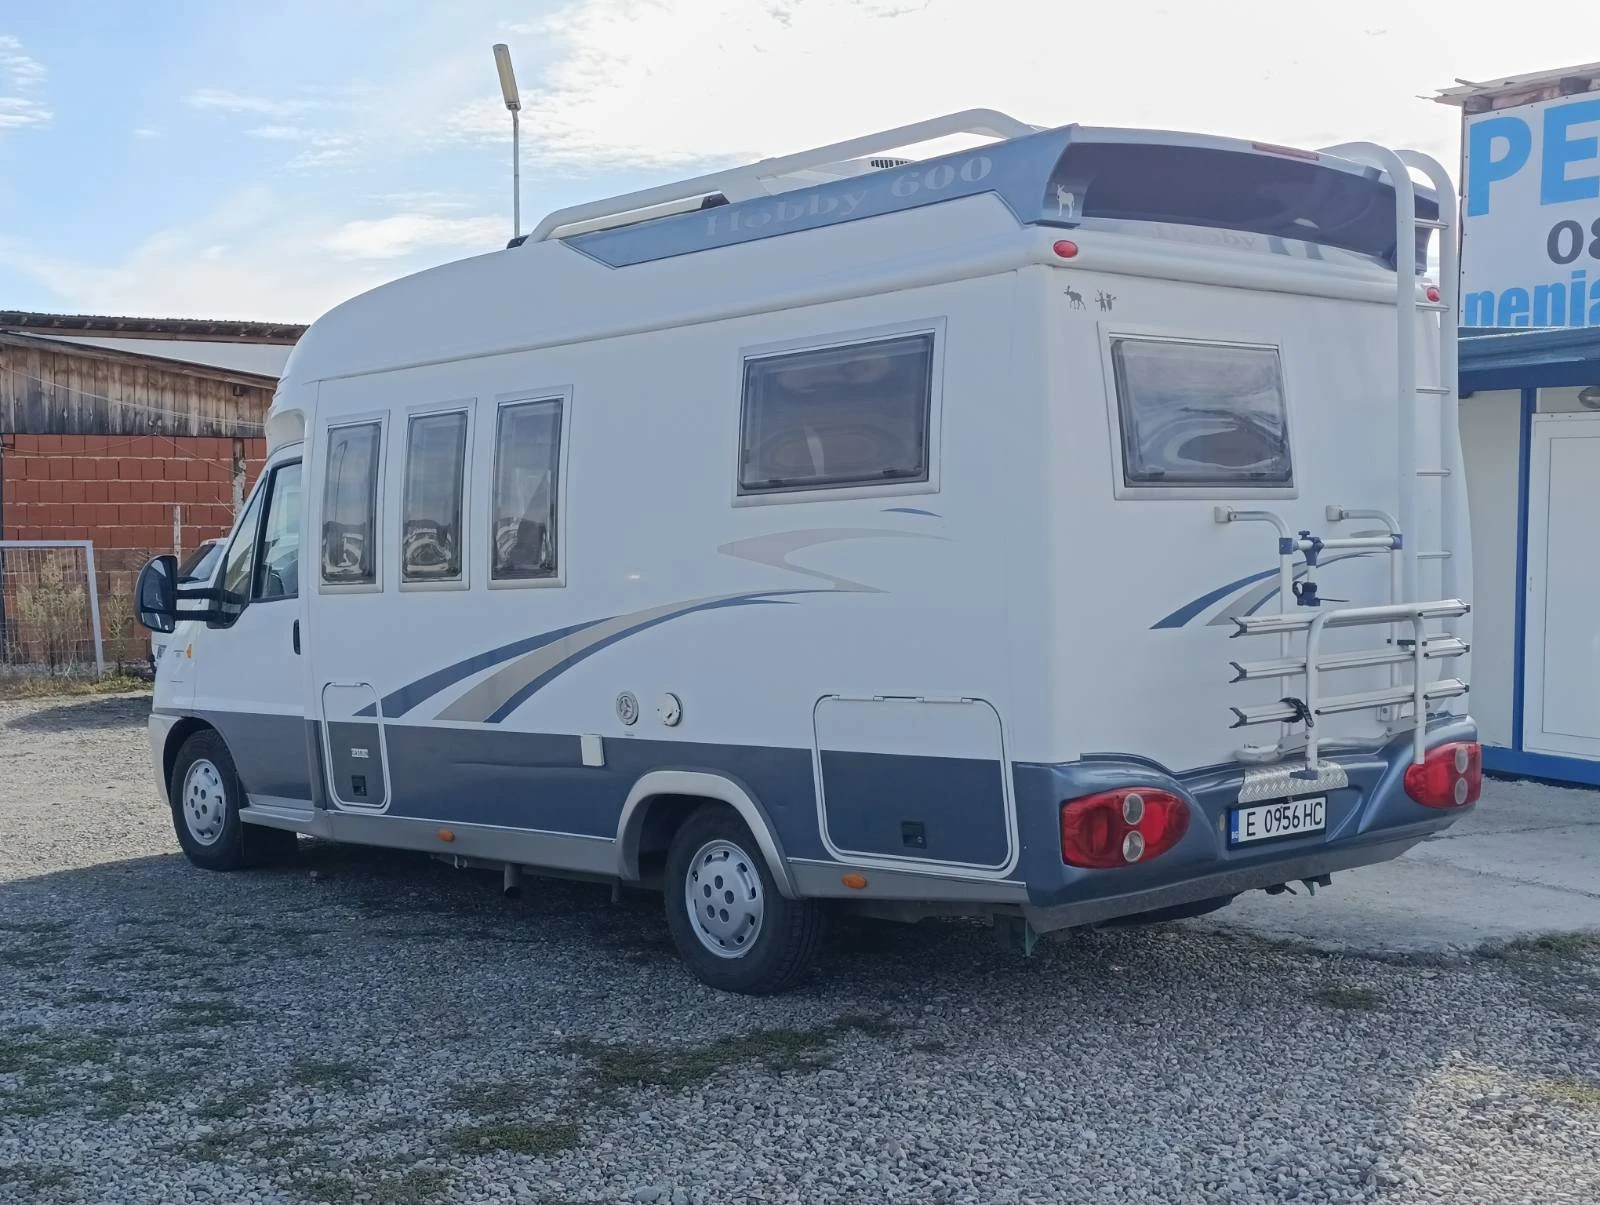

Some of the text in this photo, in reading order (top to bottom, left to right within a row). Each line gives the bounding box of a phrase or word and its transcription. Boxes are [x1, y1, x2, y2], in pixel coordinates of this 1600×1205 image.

[705, 157, 992, 236] Hobby 600
[1246, 802, 1323, 836] E 0956 HC
